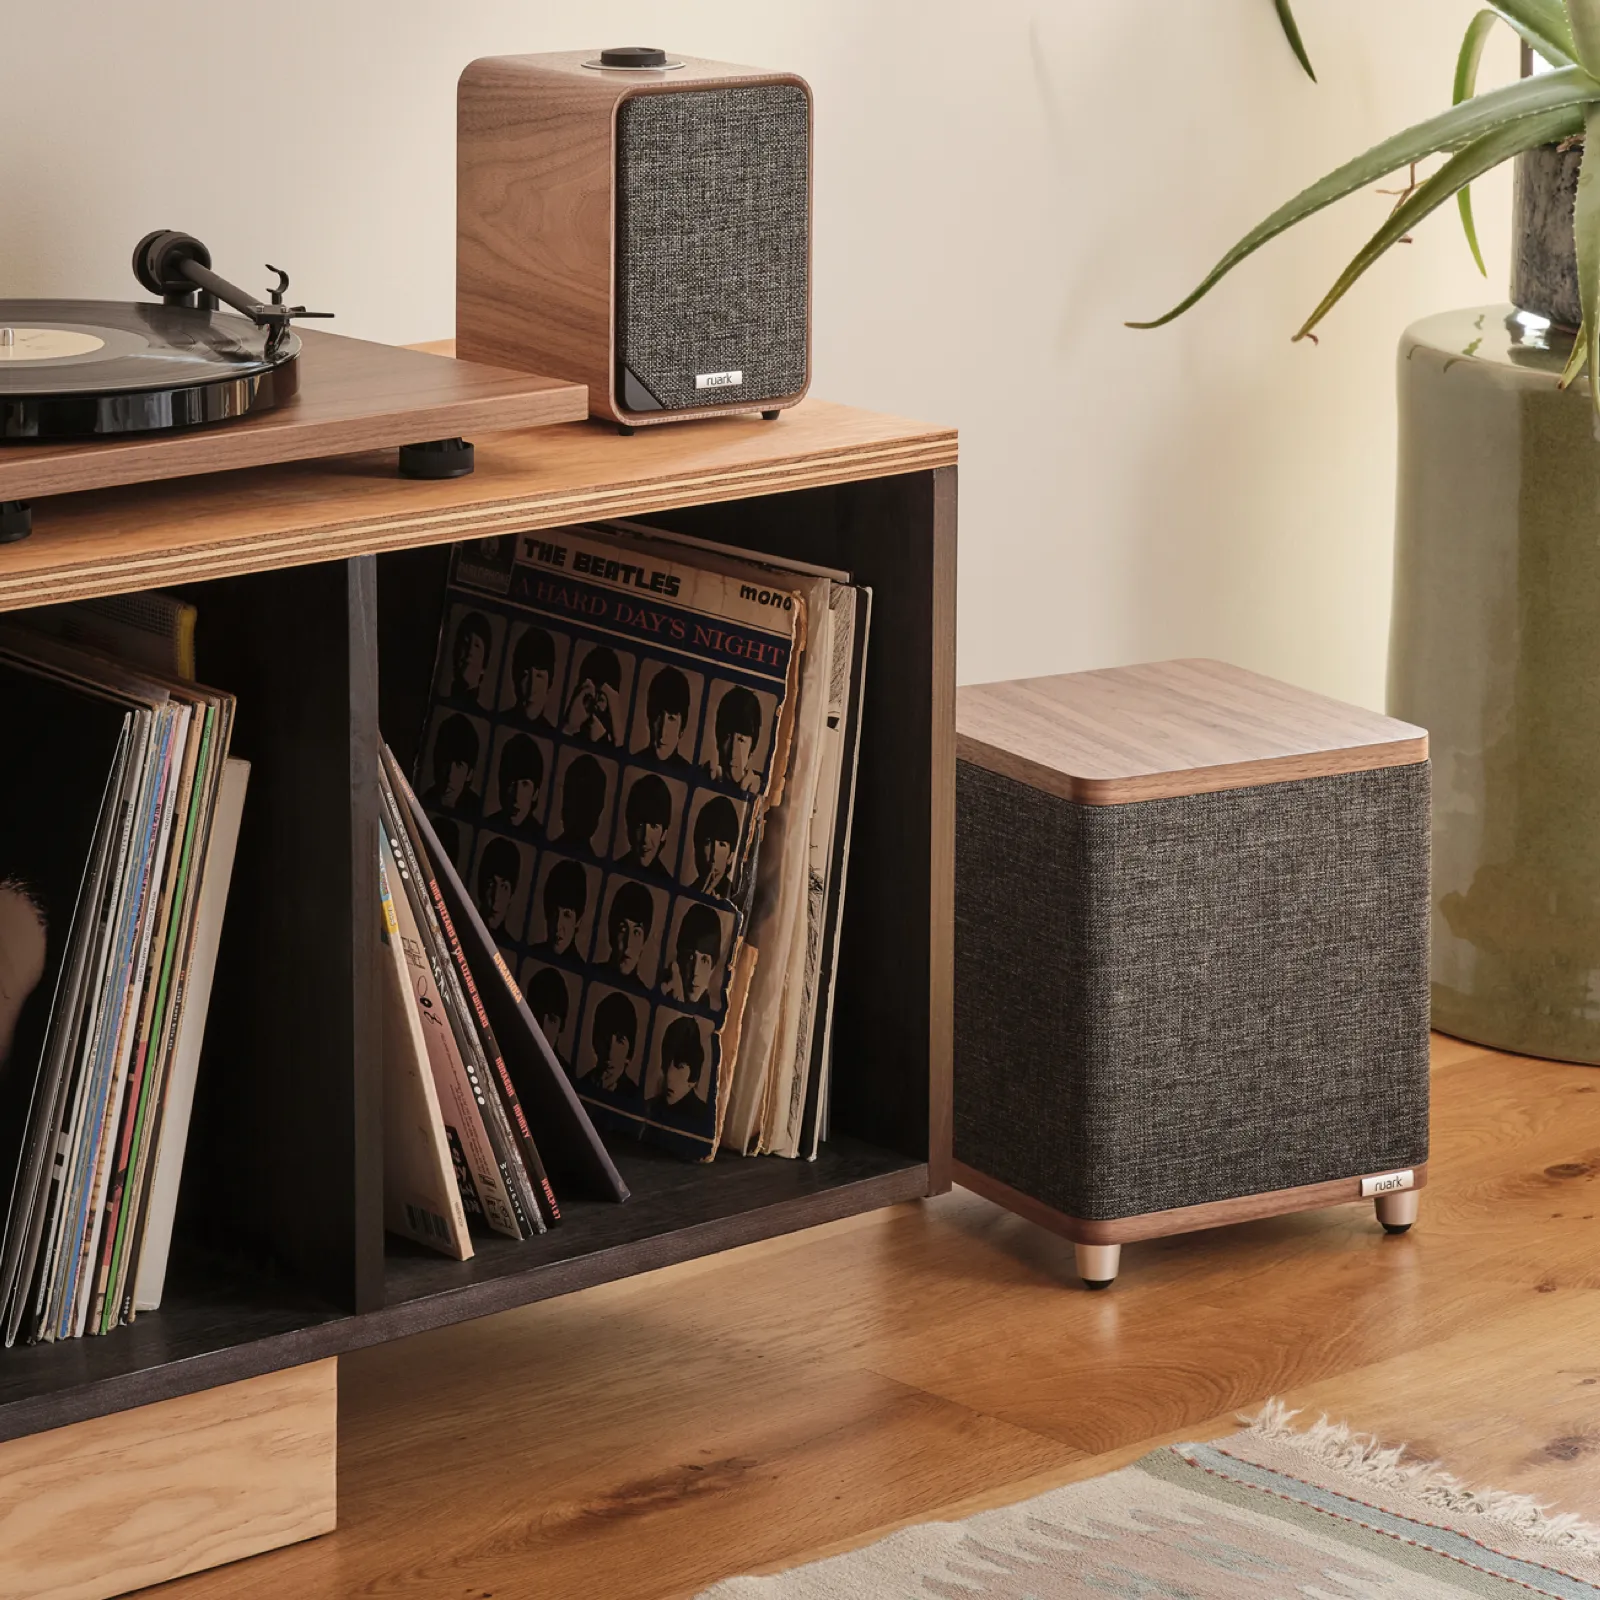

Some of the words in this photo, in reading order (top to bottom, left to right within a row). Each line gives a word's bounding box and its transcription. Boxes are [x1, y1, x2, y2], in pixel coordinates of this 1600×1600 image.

[706, 373, 732, 386] ruark
[524, 538, 568, 566] THE
[573, 552, 681, 597] BEATLES
[740, 584, 792, 610] mono
[516, 578, 529, 596] A
[537, 581, 608, 616] HARD
[615, 603, 685, 640] DAY'S
[692, 624, 784, 667] NIGHT
[472, 992, 489, 1028] WIZARD
[1375, 1176, 1403, 1191] ruark
